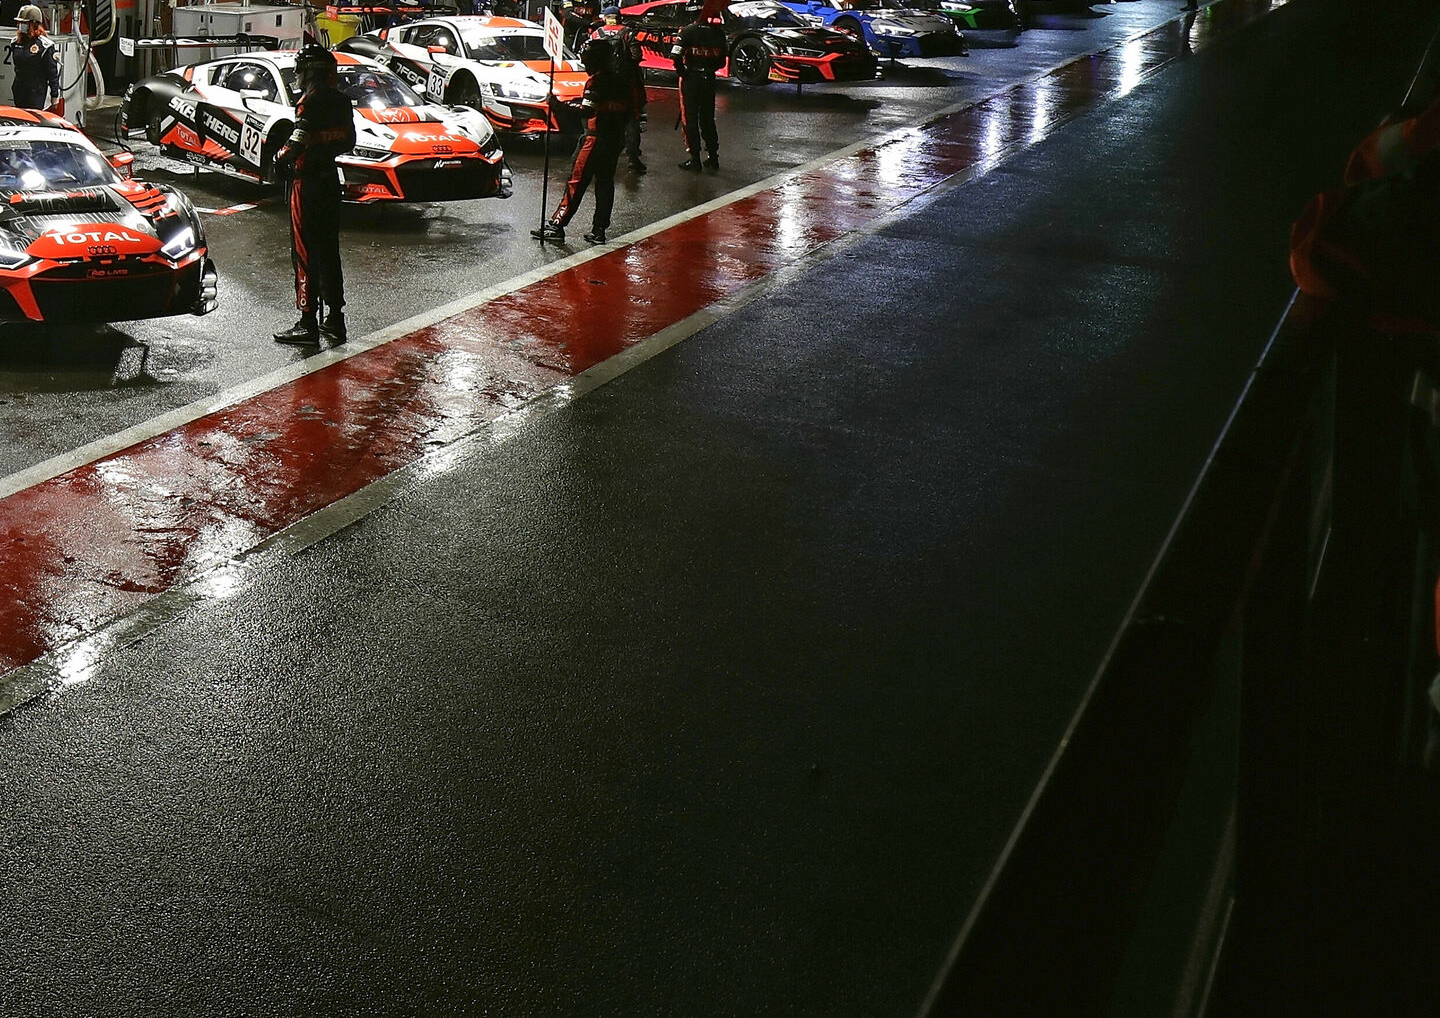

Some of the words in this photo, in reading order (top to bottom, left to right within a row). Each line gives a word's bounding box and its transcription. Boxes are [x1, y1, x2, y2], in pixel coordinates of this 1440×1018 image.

[645, 32, 671, 44] Audi
[430, 74, 443, 97] 33
[177, 126, 202, 148] TOTAL
[245, 127, 260, 157] 32
[403, 132, 462, 143] TOTAL
[46, 230, 141, 245] TOTAL
